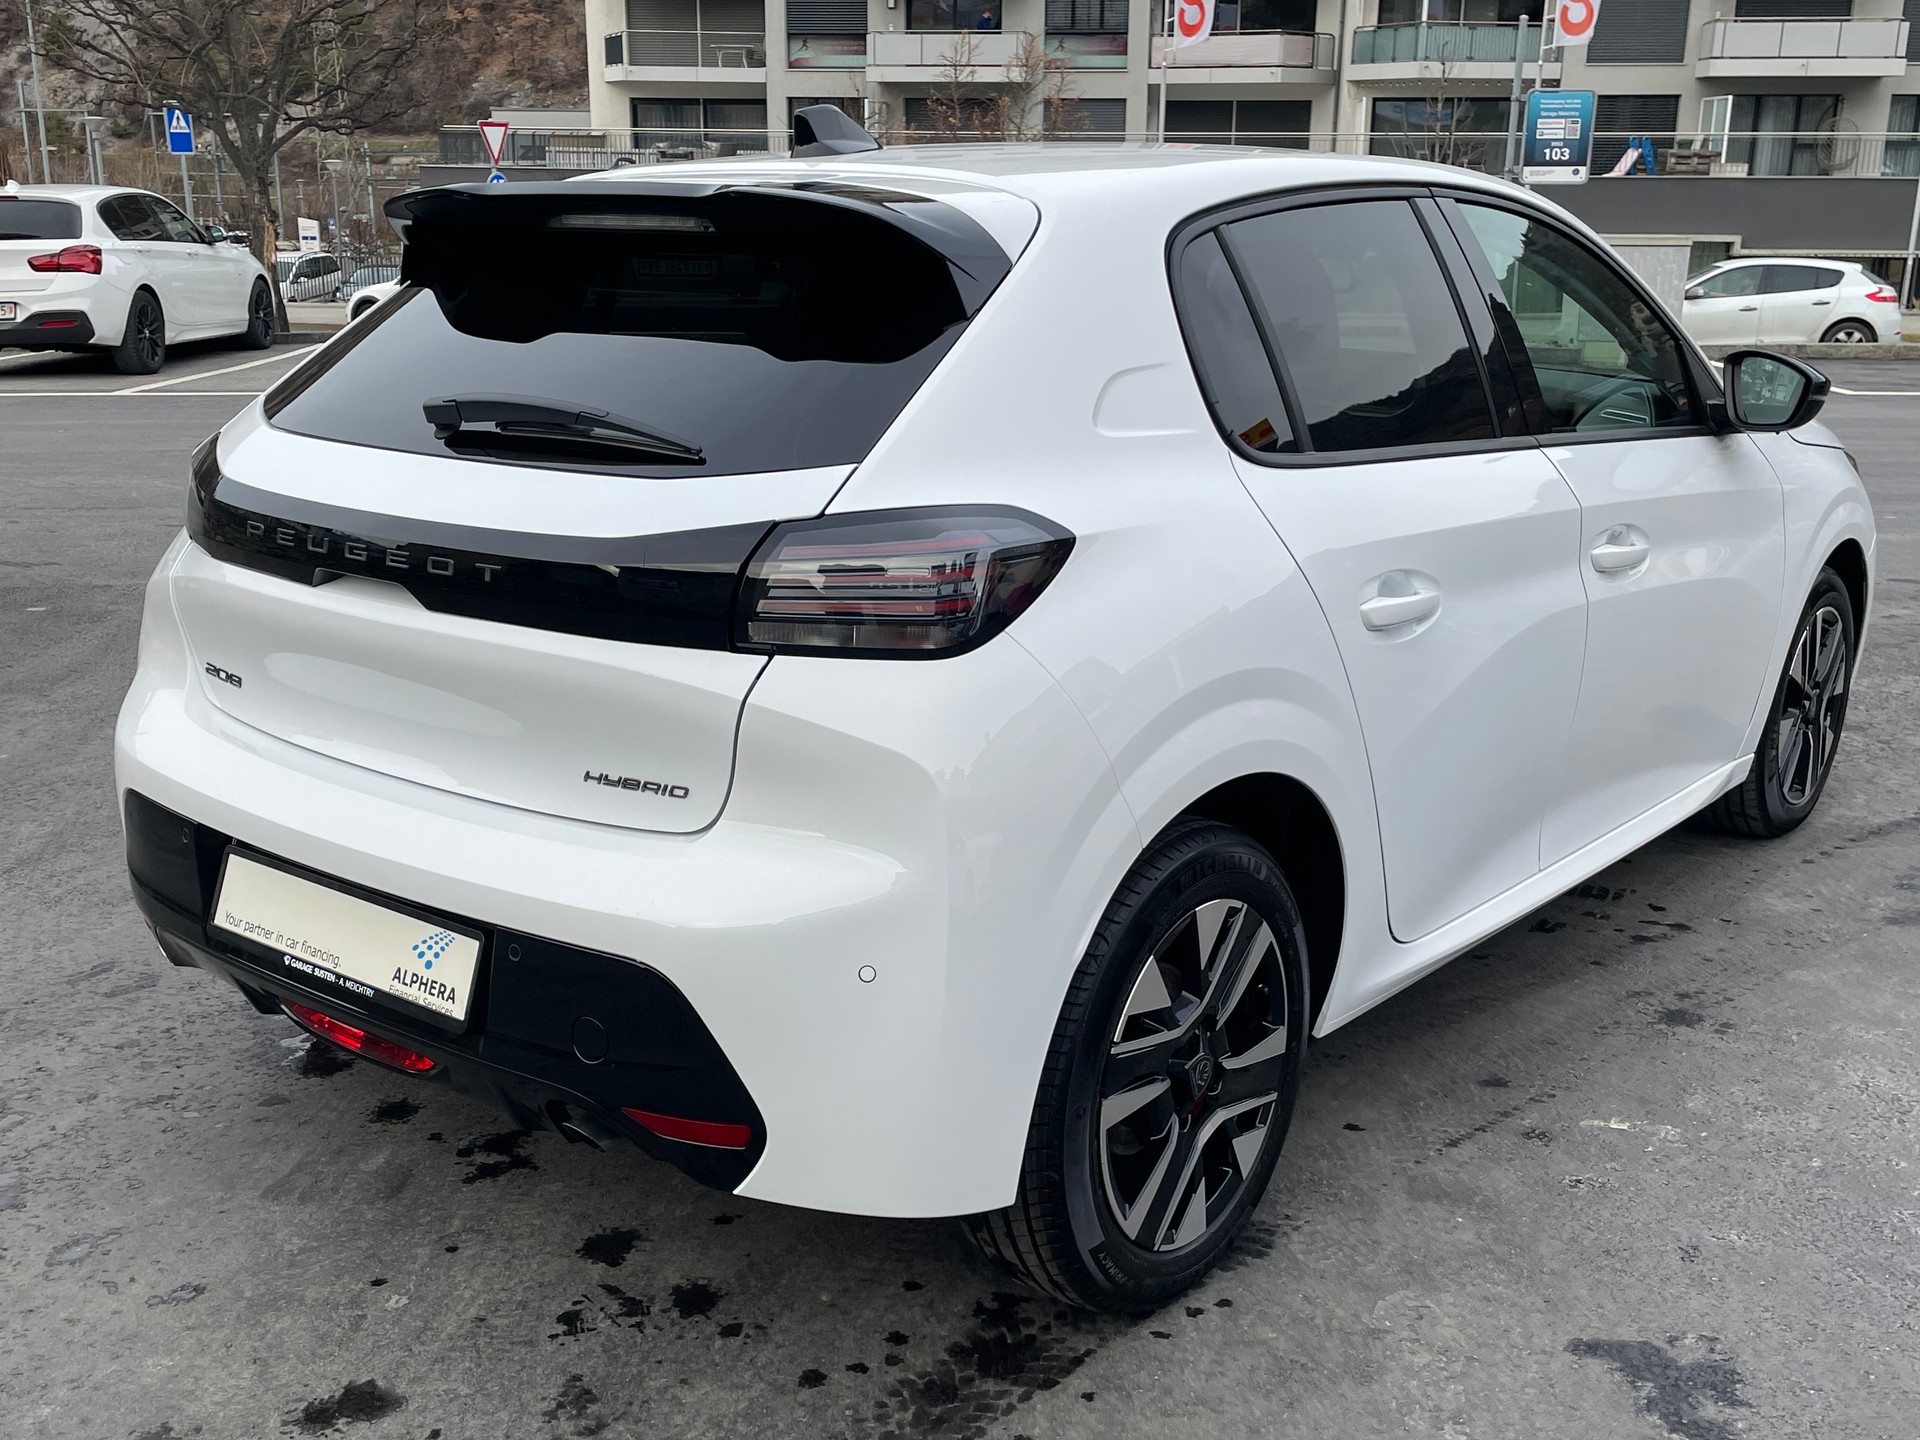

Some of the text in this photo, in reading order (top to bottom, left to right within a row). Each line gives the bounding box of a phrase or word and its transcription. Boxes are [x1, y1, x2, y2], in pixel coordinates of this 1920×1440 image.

[1543, 147, 1570, 161] 103
[246, 520, 502, 582] PEUGEOT
[205, 662, 242, 689] 208
[583, 770, 690, 799] HYBRID
[225, 910, 341, 969] Your partner in car financing.
[290, 958, 314, 974] GARAGE
[314, 967, 336, 983] SUSTEN
[345, 979, 375, 998] MEICHTRY
[391, 966, 456, 1005] ALPHERA
[388, 985, 454, 1017] Financial Services
